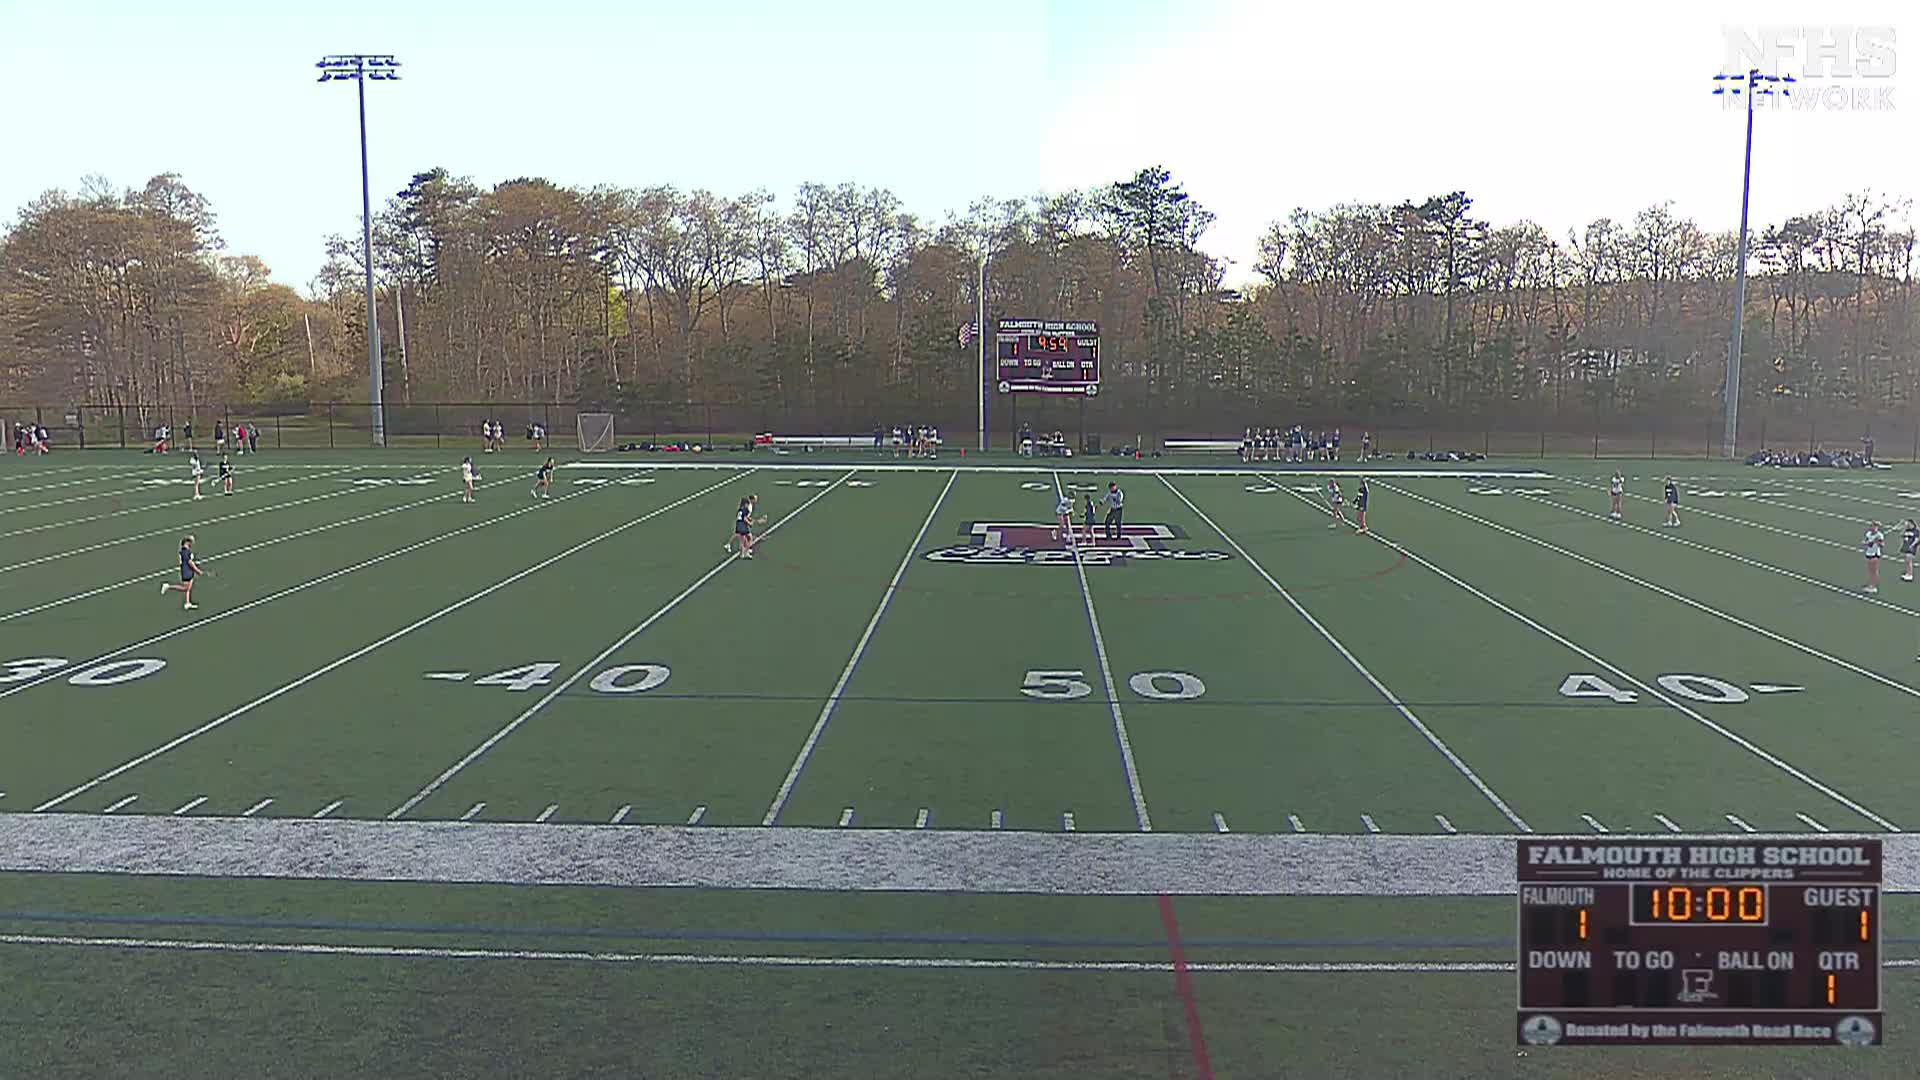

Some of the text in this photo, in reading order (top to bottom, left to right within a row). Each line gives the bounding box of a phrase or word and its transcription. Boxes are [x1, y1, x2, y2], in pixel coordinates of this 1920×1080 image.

[473, 662, 672, 693] 40
[1019, 671, 1207, 699] 50
[1558, 674, 1750, 703] 40
